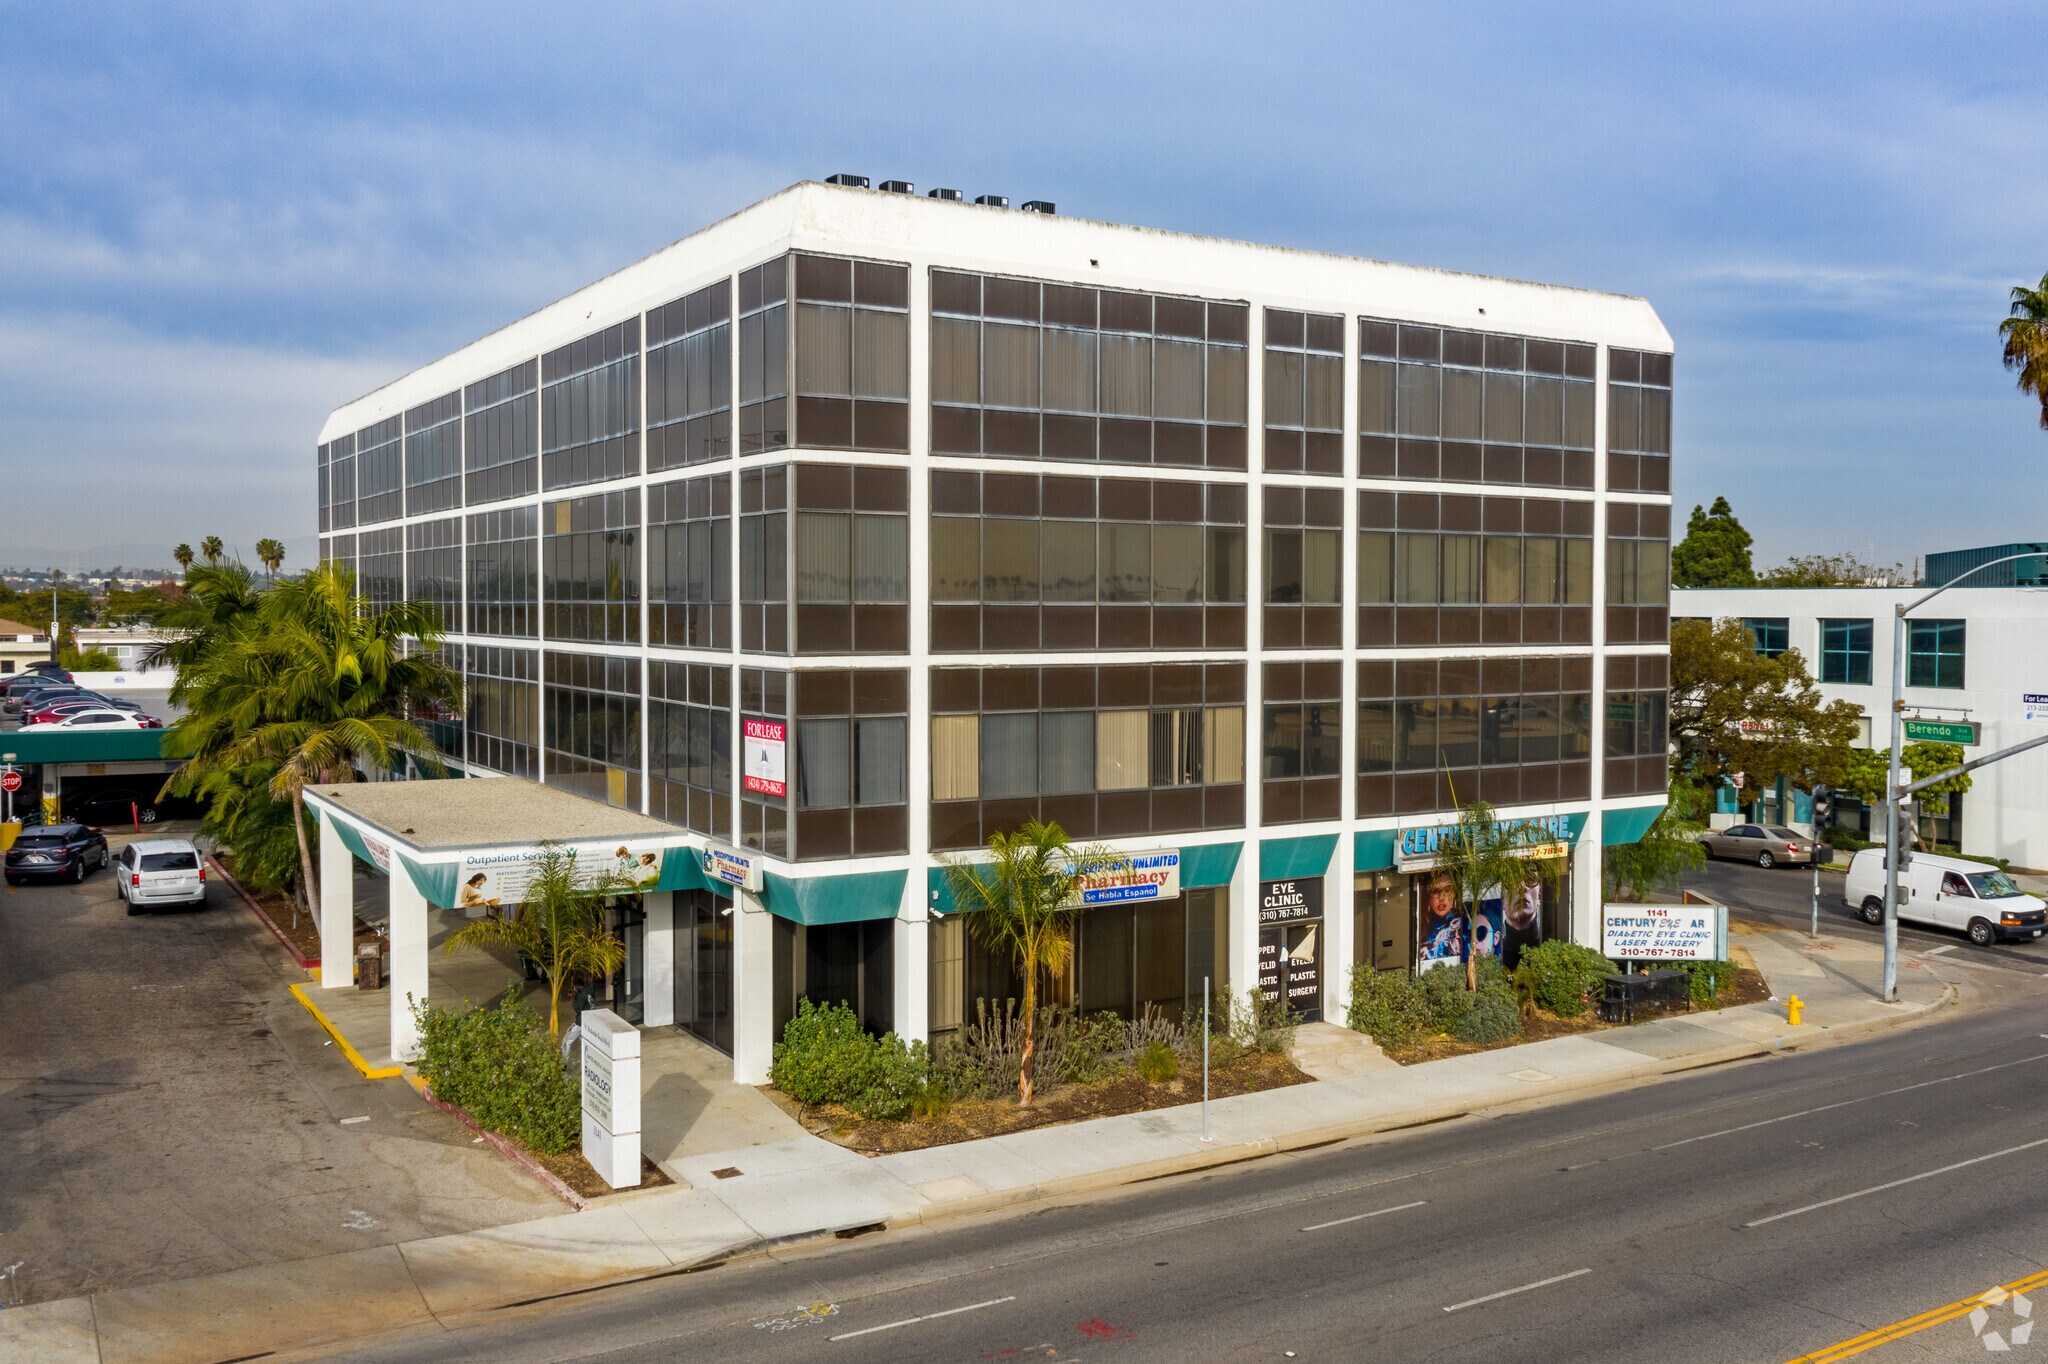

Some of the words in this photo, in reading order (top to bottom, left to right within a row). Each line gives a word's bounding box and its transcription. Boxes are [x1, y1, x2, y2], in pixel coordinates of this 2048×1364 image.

[747, 722, 762, 737] FOR
[762, 724, 782, 740] LEASE
[1908, 723, 1951, 736] Berendo
[3, 777, 20, 786] STOP
[1403, 821, 1481, 855] CENTUR
[1528, 815, 1569, 843] CARE
[467, 853, 520, 865] Outpatient
[522, 850, 561, 861] Services
[1133, 854, 1179, 869] UNLIMITED
[716, 858, 747, 880] Pharmacy
[1071, 871, 1170, 890] Pharmacy
[1098, 890, 1122, 900] Habla
[1124, 886, 1157, 898] Español
[1272, 882, 1295, 894] EYE
[1264, 893, 1303, 908] CLINIC
[1259, 910, 1277, 922] (310)
[1278, 907, 1308, 919] 767-7814
[1646, 909, 1668, 917] 1141
[1607, 917, 1657, 928] CENTURY
[1690, 919, 1705, 928] AR
[1656, 930, 1677, 938] EYE
[1679, 931, 1711, 939] CLINIC
[1614, 939, 1647, 947] LASER
[1653, 939, 1703, 947] SURGERY
[1259, 945, 1275, 954] PPER
[1620, 948, 1696, 957] 310-767-7814
[1259, 960, 1276, 970] ELID
[1291, 956, 1314, 966] EYED
[1259, 976, 1278, 986] ASTIC
[1290, 970, 1316, 982] PLASTIC
[1288, 985, 1318, 998] SURGERY
[584, 1065, 612, 1096] RADIOLOGY
